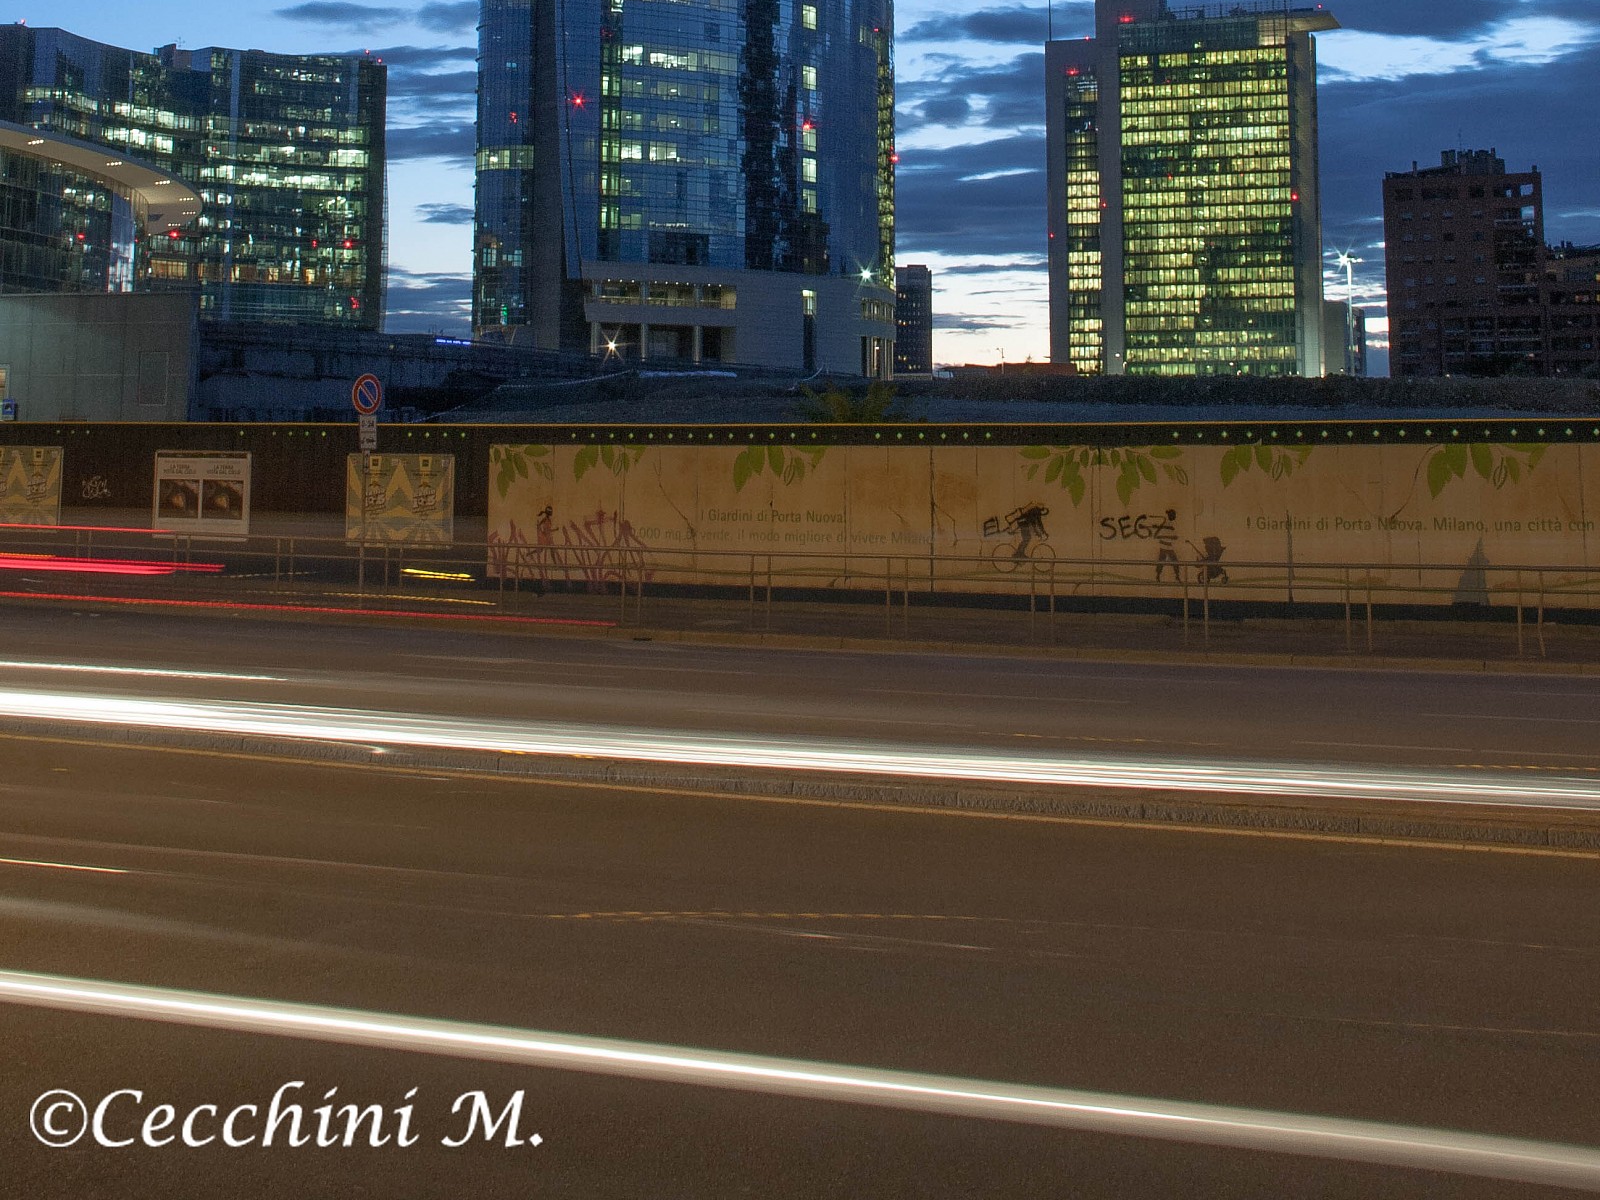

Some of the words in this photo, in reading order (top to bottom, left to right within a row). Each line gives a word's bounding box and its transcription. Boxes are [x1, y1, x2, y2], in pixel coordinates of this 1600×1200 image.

[708, 508, 753, 522] Giardini
[757, 509, 768, 522] di
[771, 509, 802, 523] Porta
[1256, 516, 1311, 530] Giardini
[1316, 516, 1328, 530] di
[1335, 516, 1372, 531] Porta
[1433, 516, 1488, 533] Milano,
[1494, 520, 1522, 532] una
[1527, 516, 1562, 532] città
[1568, 520, 1595, 532] con
[784, 529, 833, 546] migliore
[850, 531, 887, 544] vivere
